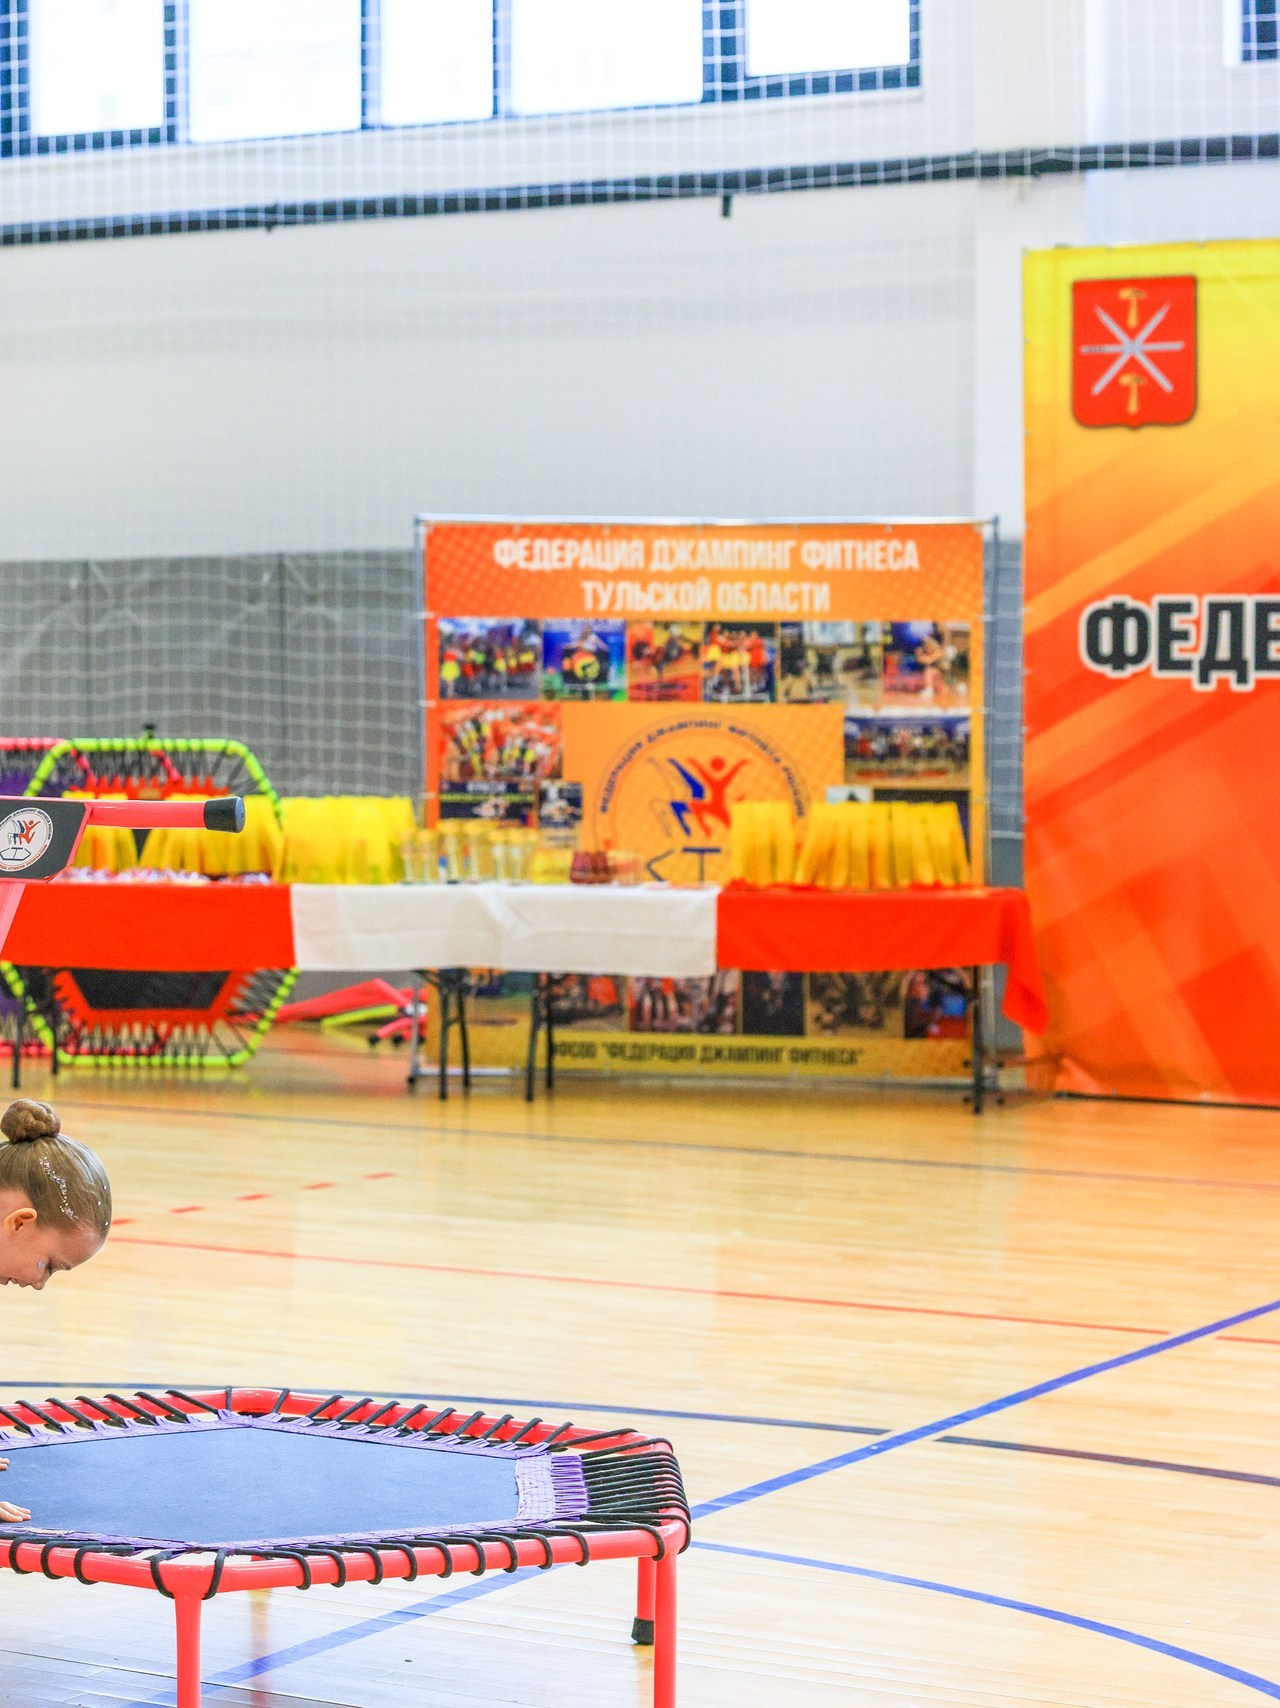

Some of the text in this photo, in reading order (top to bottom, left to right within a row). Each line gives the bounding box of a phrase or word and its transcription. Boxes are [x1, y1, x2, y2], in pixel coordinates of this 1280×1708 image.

[492, 538, 920, 573] ФЕДЕРАЦИЯ ДЖАМПИНГ ФИТНЕСА
[580, 576, 831, 612] ТУЛЬСКОЙ ОБЛАСТИ
[1079, 594, 1280, 692] ФЕДЕ
